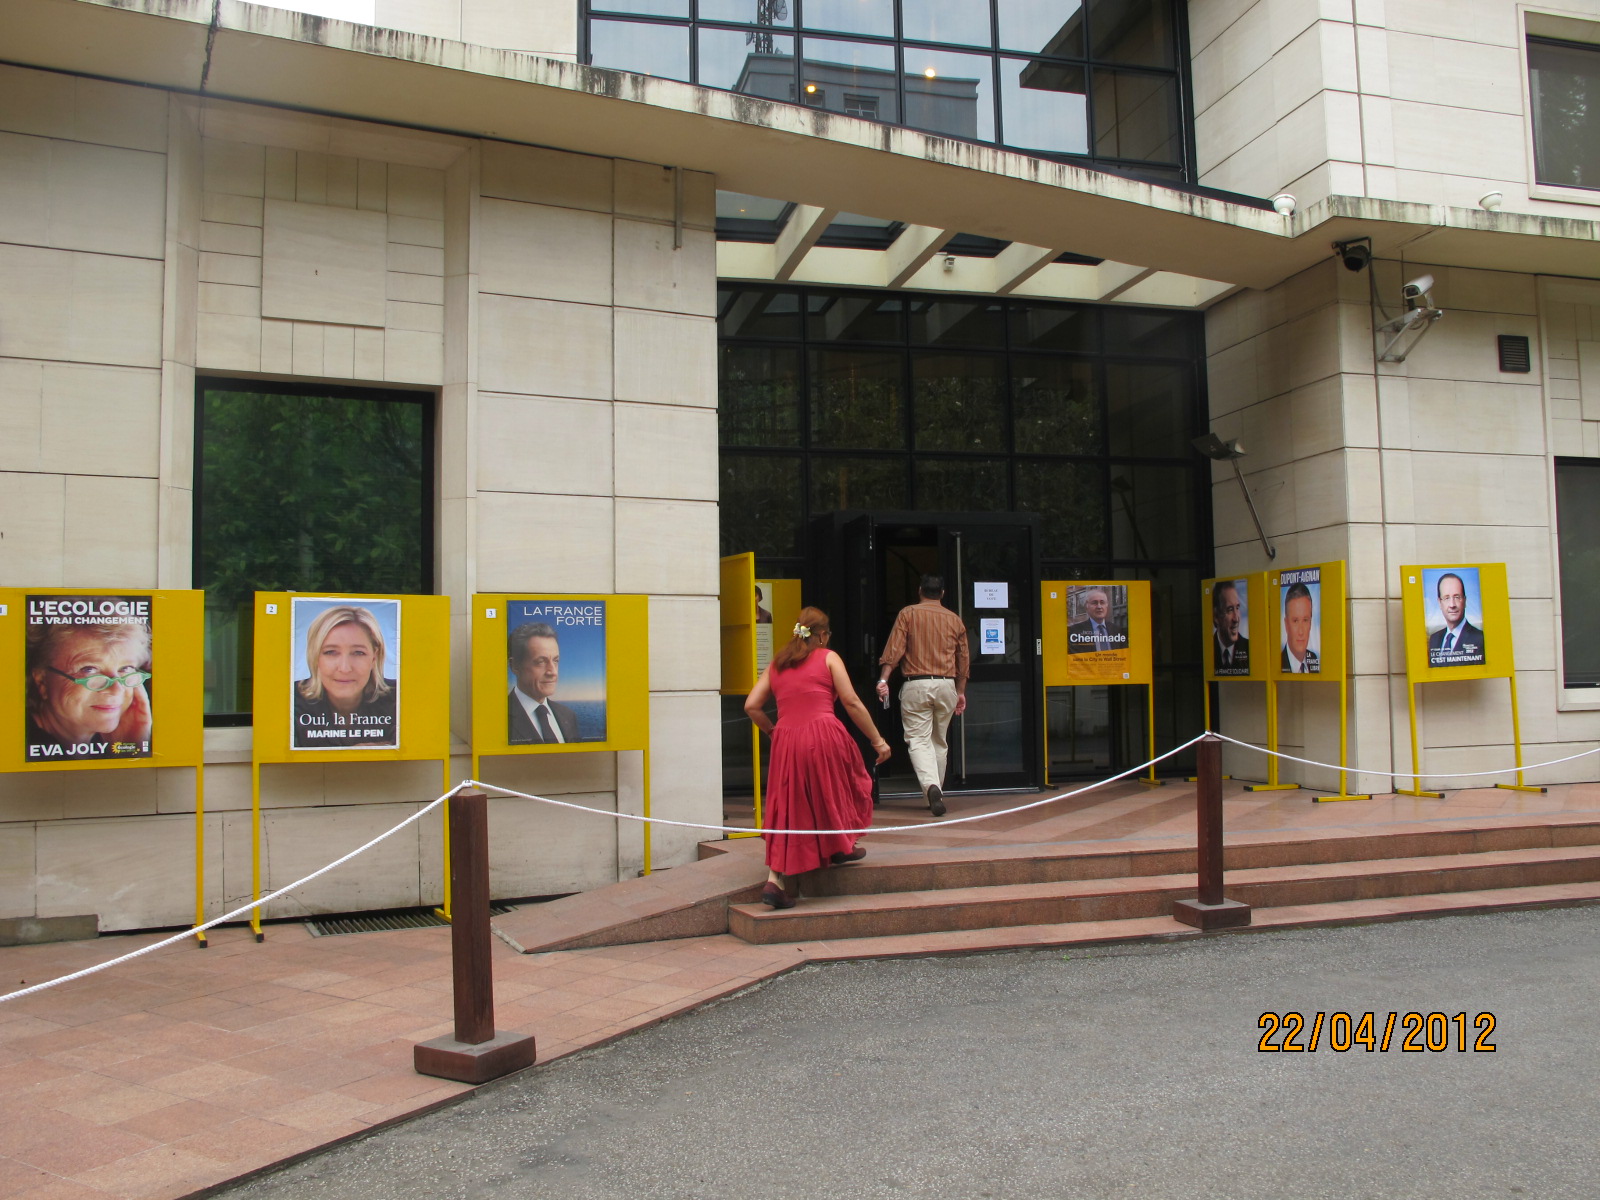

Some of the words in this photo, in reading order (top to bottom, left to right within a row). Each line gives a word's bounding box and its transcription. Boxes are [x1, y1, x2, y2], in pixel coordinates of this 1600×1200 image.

[1280, 570, 1320, 584] DUPONT-AIGNAN
[30, 601, 149, 616] L'ECOLOGIE
[524, 606, 542, 616] LA
[545, 606, 603, 616] FRANCE
[30, 617, 43, 625] LE
[45, 617, 72, 625] VRAI
[74, 617, 149, 625] CHANGEMENT
[556, 616, 603, 626] FORTE
[1070, 633, 1126, 643] Cheminade
[299, 713, 330, 726] Oui,
[334, 713, 346, 725] la
[350, 713, 392, 725] France
[307, 729, 347, 738] MARINE
[349, 729, 362, 738] LE
[364, 729, 384, 738] PEN
[29, 744, 64, 757] EVA
[66, 742, 109, 755] JOLY
